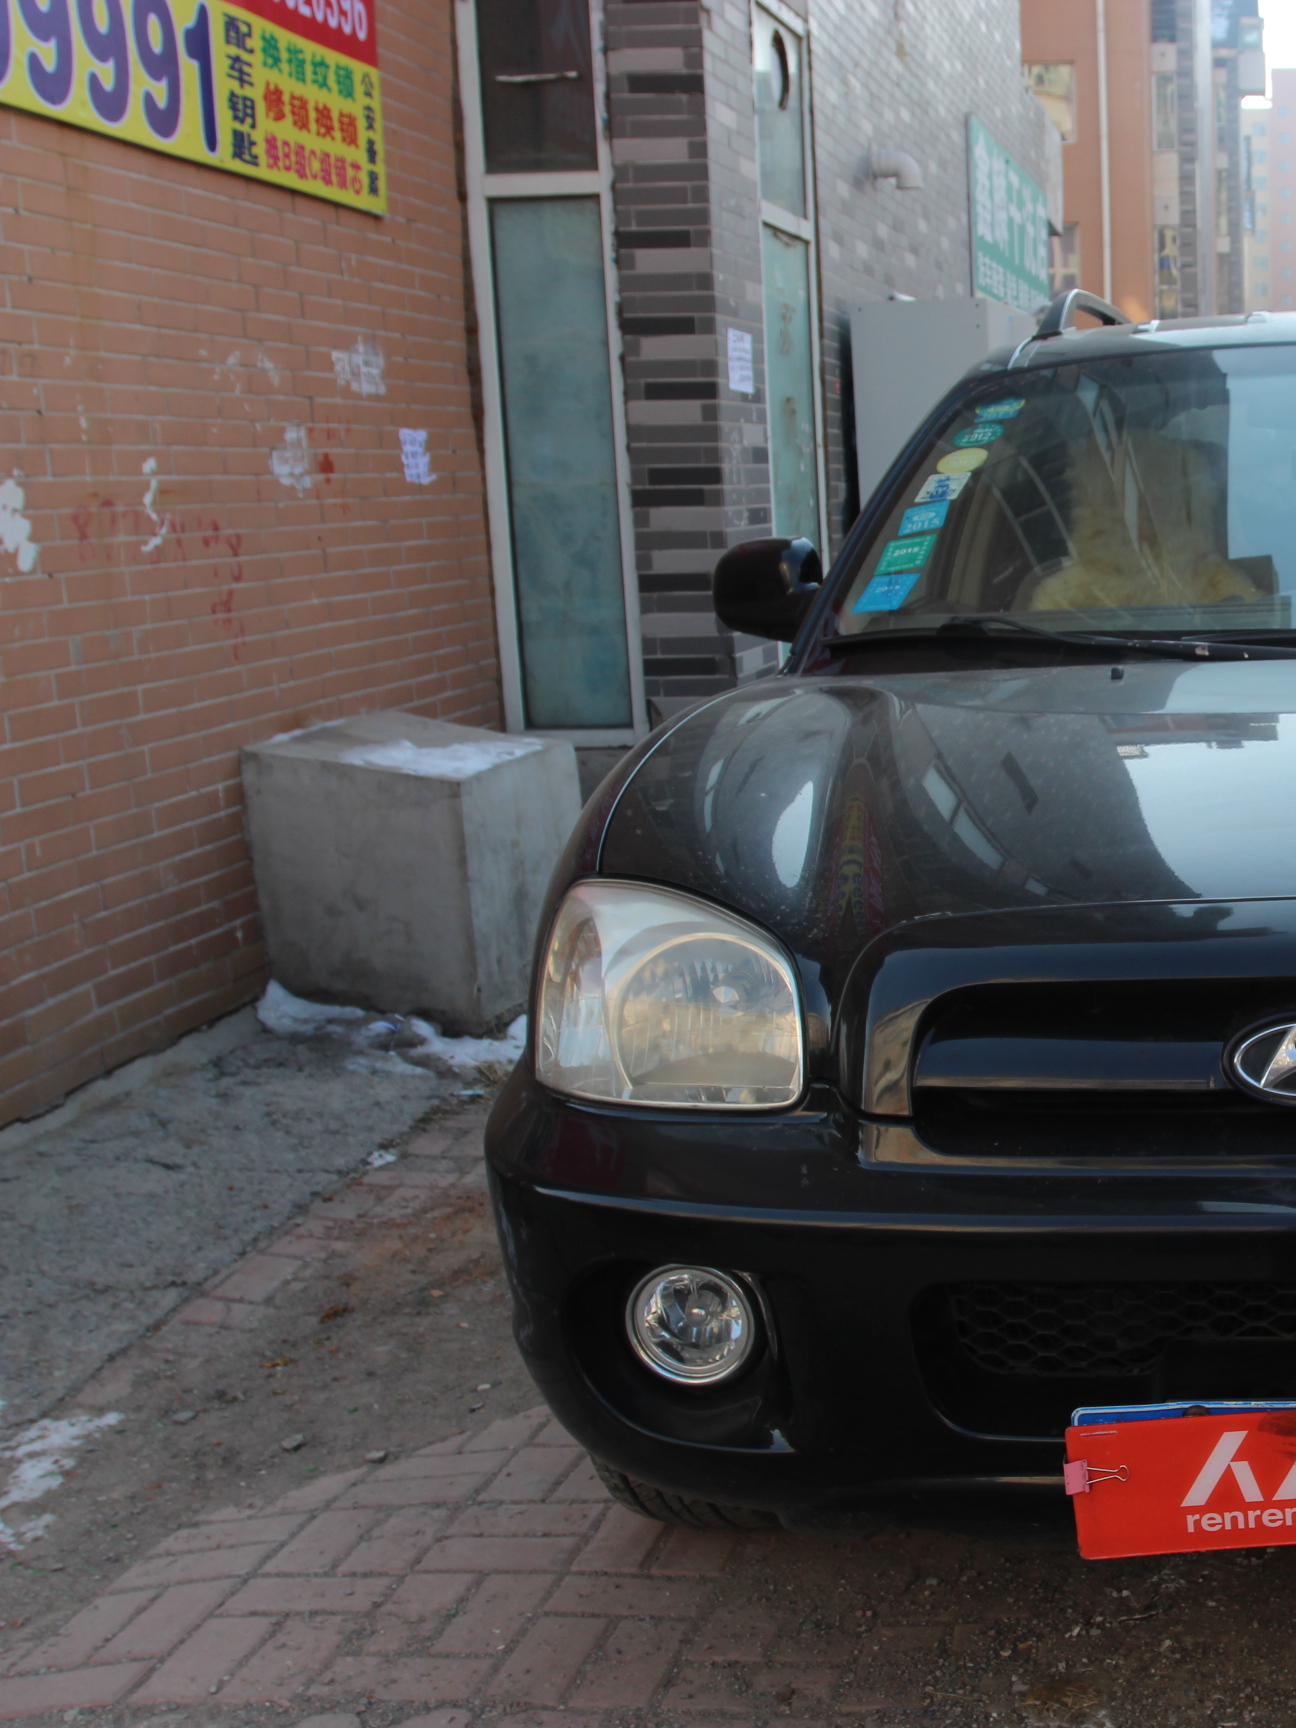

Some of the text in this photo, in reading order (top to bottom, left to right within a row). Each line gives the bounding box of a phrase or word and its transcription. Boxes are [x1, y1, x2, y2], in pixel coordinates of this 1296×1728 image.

[0, 0, 219, 155] 9991
[222, 12, 260, 167] 配车钥匙
[260, 28, 356, 102] 换指纹锁
[263, 80, 360, 149] 修锁换锁
[361, 72, 380, 198] 公安备案
[264, 133, 364, 196] 换B级C级锁芯
[893, 546, 920, 557] 2015
[903, 517, 941, 532] 2015
